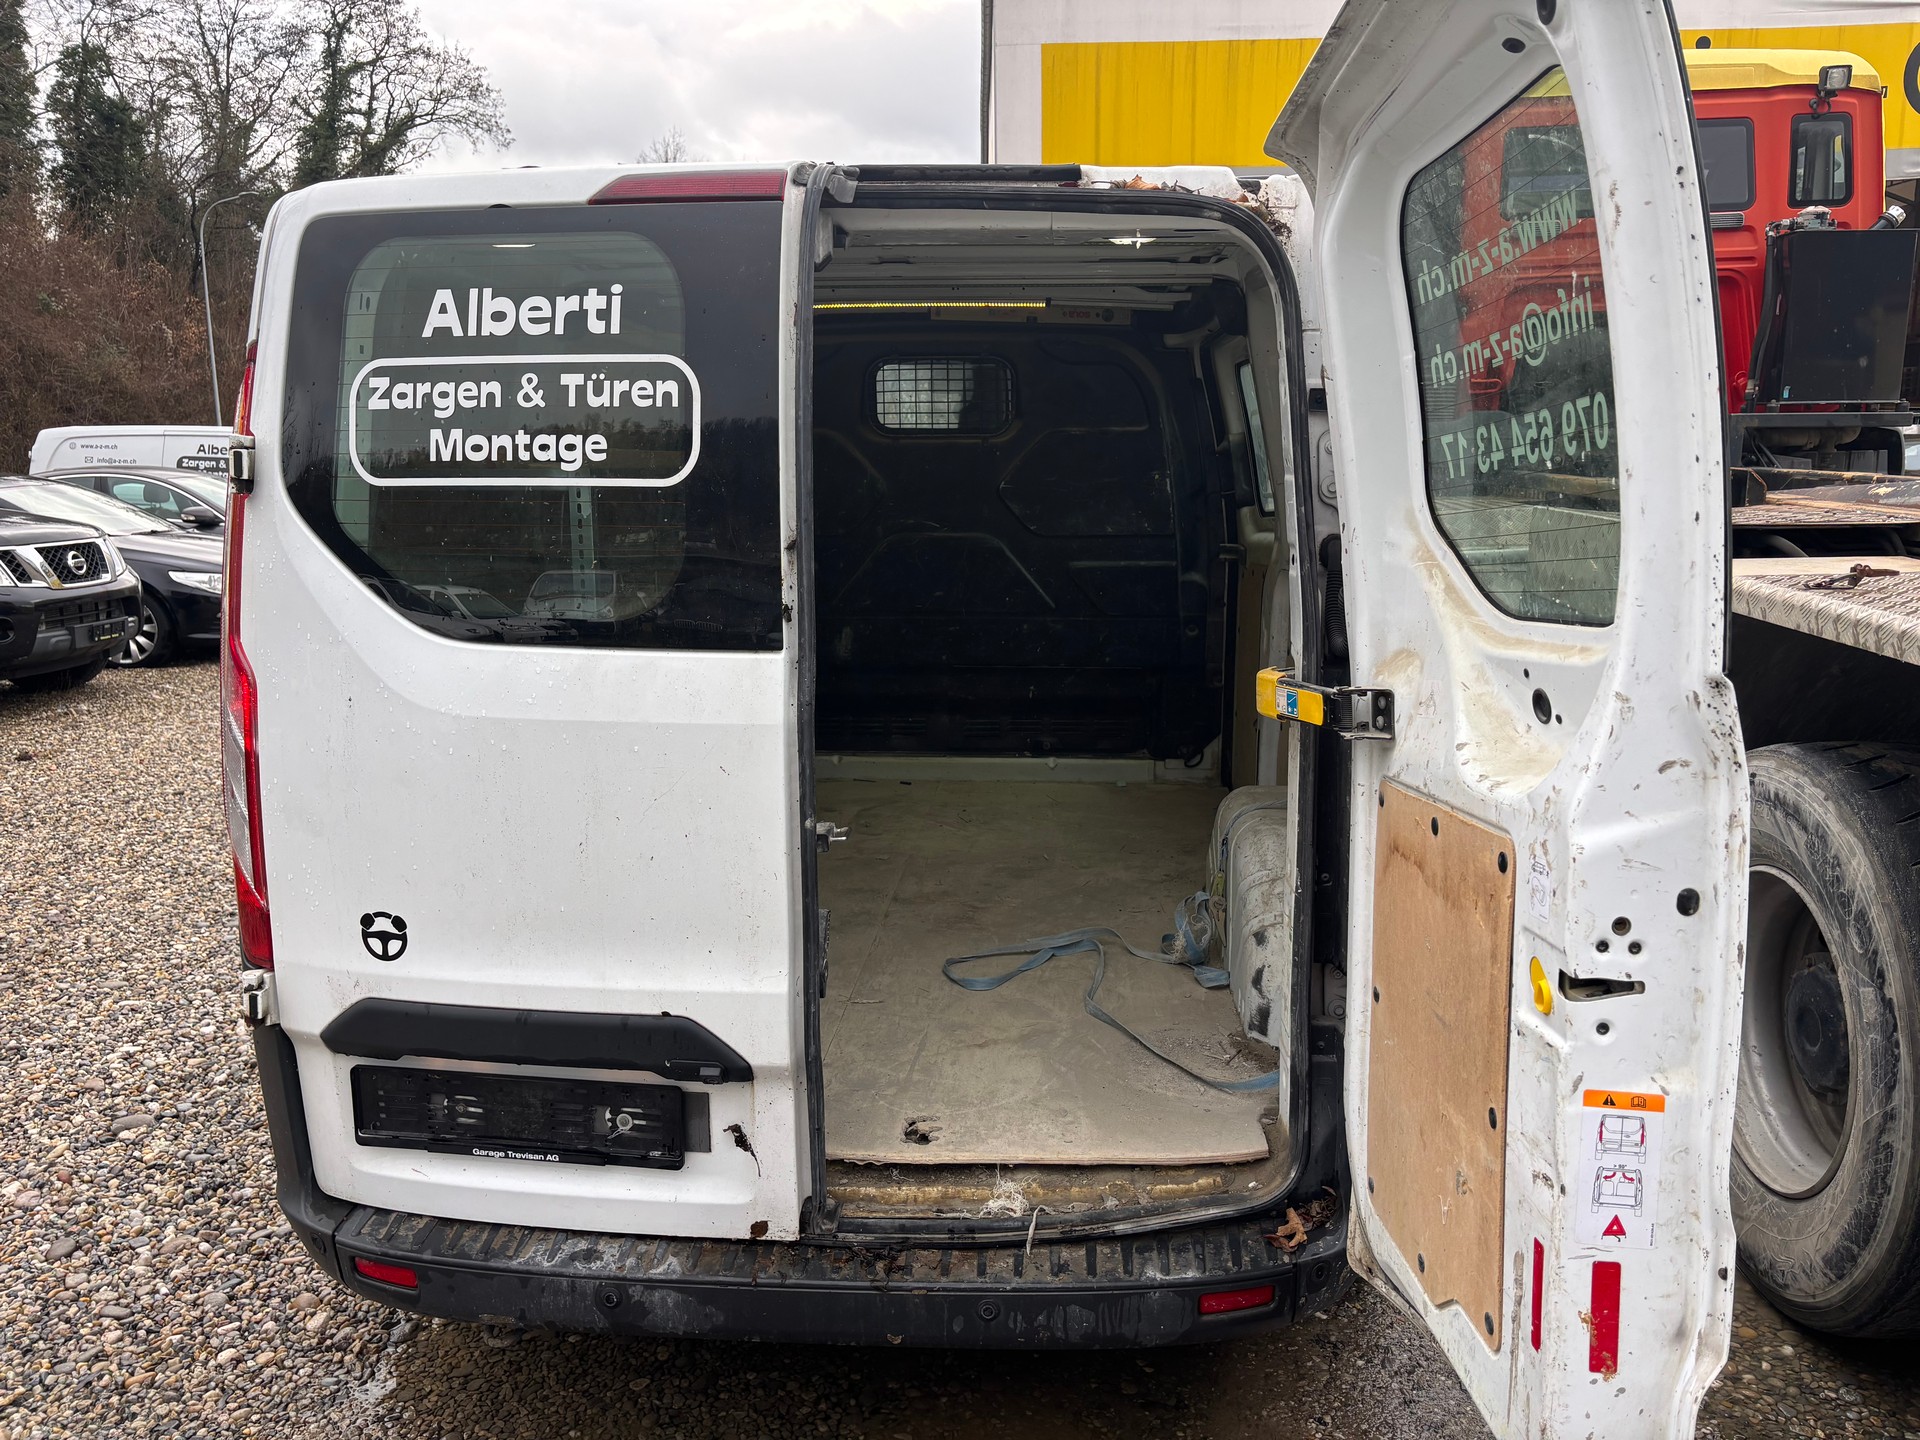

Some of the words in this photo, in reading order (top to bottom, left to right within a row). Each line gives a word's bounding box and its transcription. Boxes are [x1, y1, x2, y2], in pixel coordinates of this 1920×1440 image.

[421, 283, 624, 338] Alberti
[368, 376, 502, 419] Zargen
[516, 372, 546, 408] &
[560, 373, 679, 408] Türen
[196, 444, 228, 455] Albe
[429, 428, 608, 472] Montage
[96, 457, 137, 465] info@a-z-m.ch
[182, 458, 216, 469] Zargen
[218, 459, 226, 468] &
[472, 1148, 505, 1158] Garage
[507, 1151, 544, 1160] Trevisan
